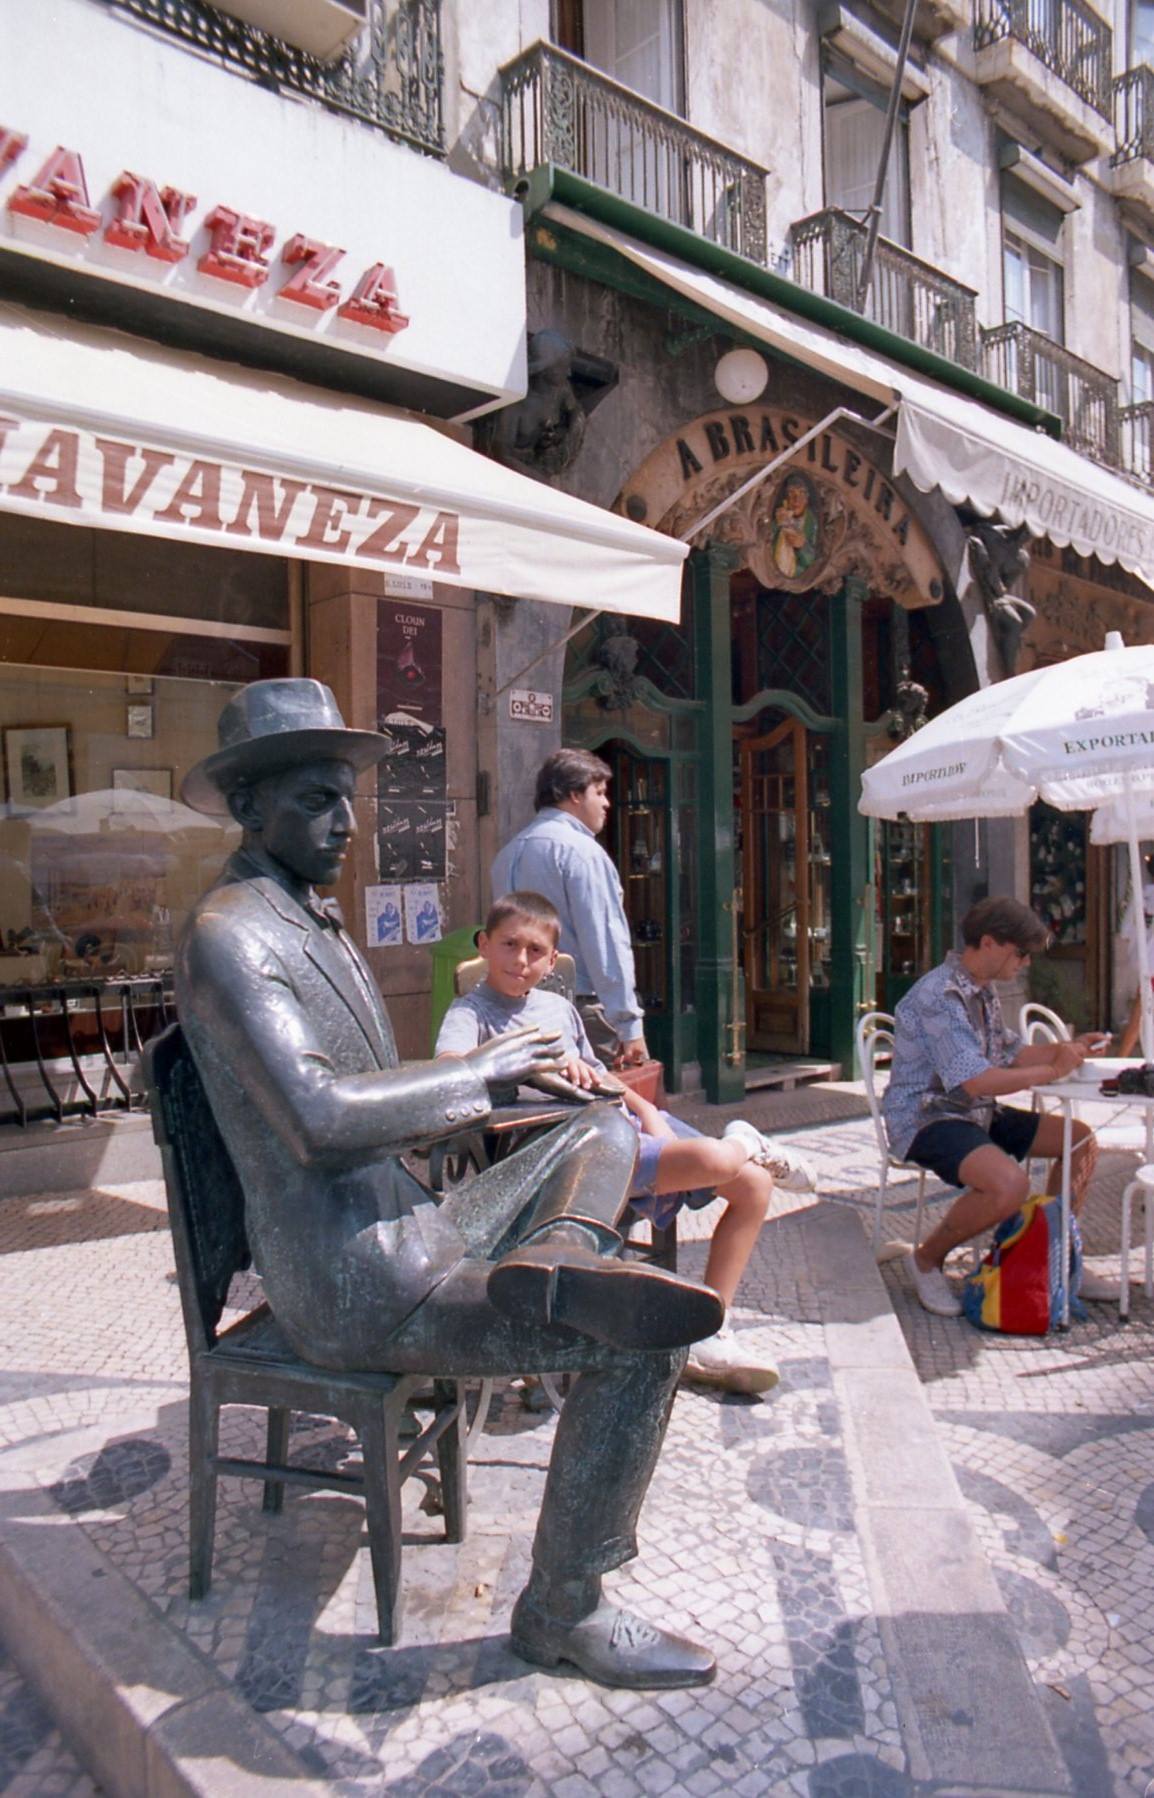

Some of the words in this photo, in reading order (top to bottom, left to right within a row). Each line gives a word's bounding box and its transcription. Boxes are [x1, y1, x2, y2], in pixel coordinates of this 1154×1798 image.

[676, 438, 703, 481] A
[704, 415, 910, 546] BRASILEIRA
[1064, 731, 1154, 754] EXPORTA
